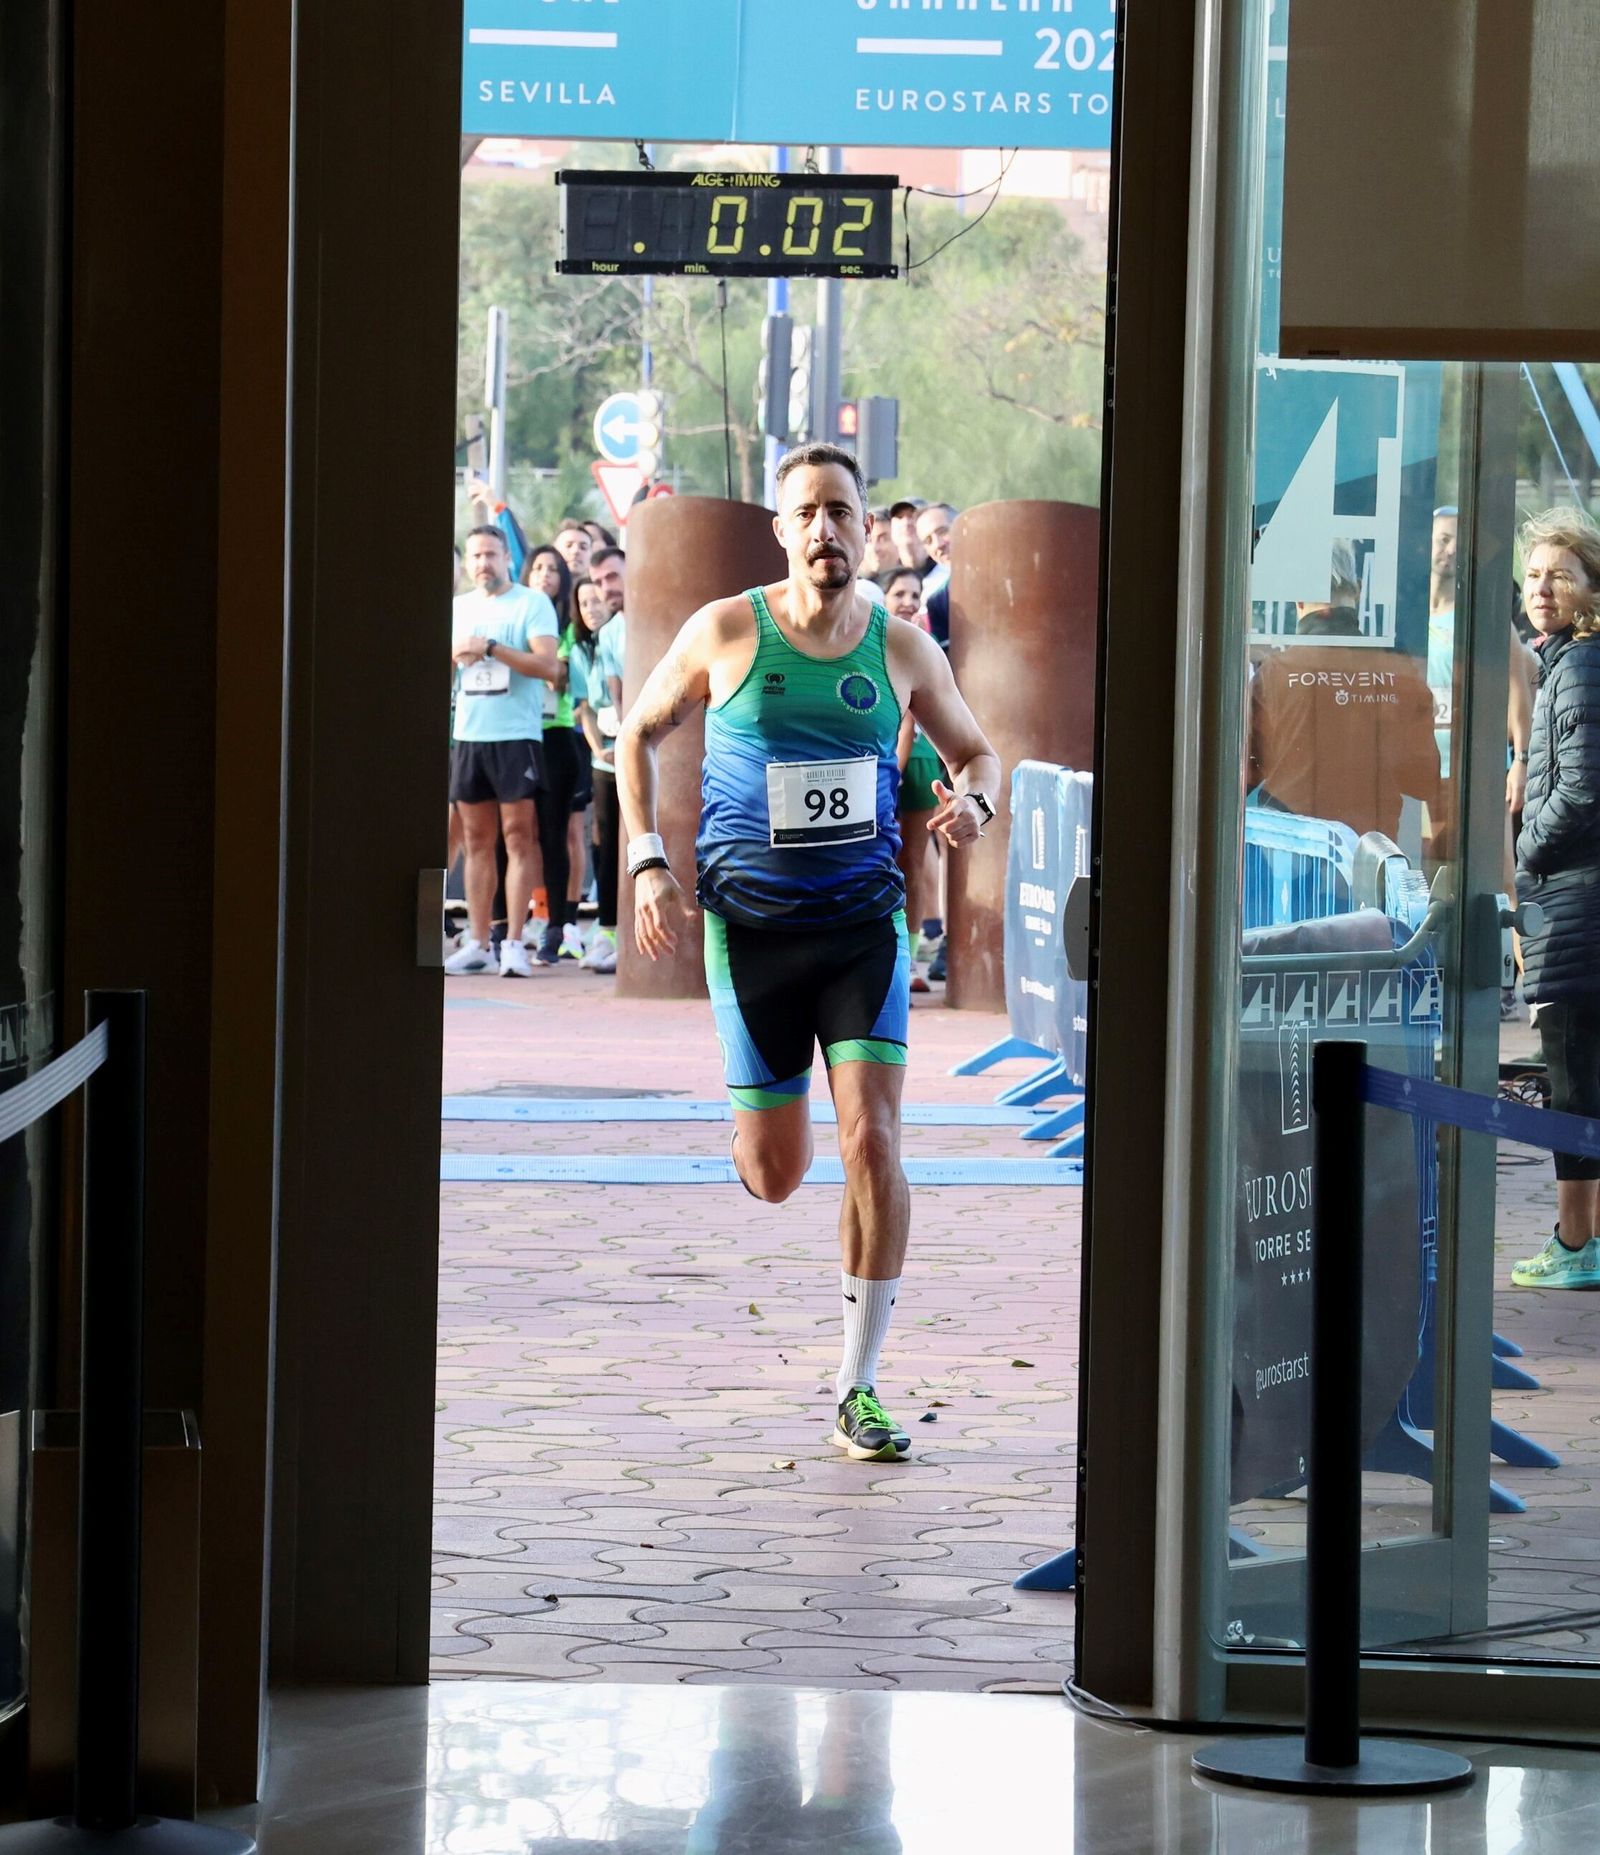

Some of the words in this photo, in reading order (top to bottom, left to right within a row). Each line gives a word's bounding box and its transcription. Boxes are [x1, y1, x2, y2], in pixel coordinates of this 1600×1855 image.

[479, 80, 616, 105] SEVILLA
[856, 89, 1051, 113] EUROSTARS
[1069, 93, 1109, 114] TO
[592, 261, 620, 272] hour
[684, 263, 709, 273] min.
[840, 265, 864, 275] sec.
[1288, 672, 1396, 688] FOREVENT
[1351, 693, 1398, 704] TIMING
[804, 787, 849, 822] 98
[1245, 1166, 1312, 1223] EUROST
[1297, 1229, 1311, 1253] SE
